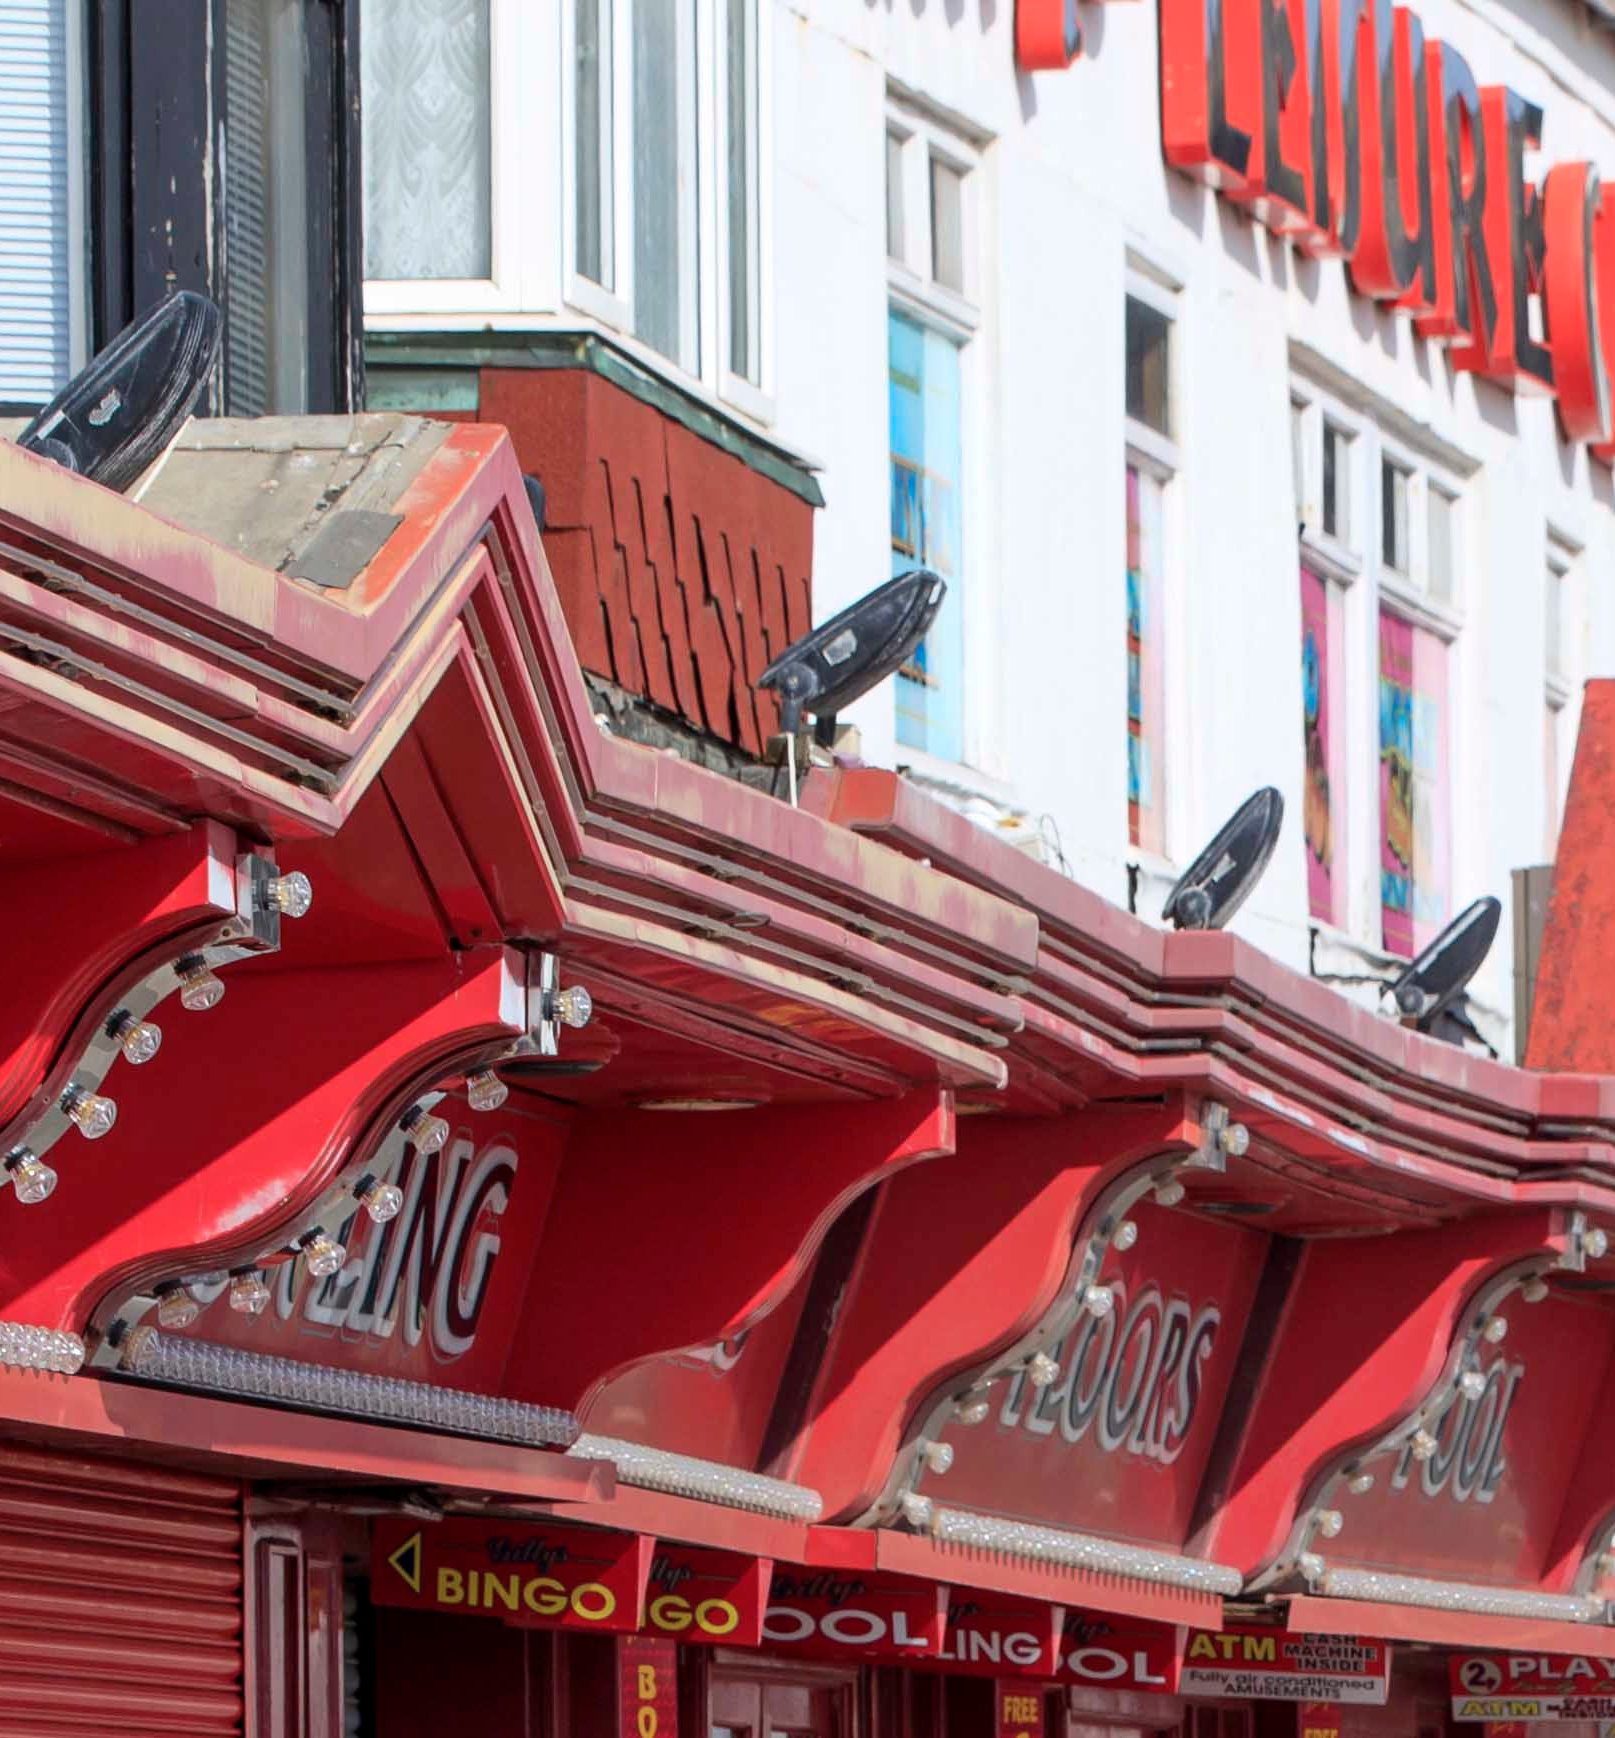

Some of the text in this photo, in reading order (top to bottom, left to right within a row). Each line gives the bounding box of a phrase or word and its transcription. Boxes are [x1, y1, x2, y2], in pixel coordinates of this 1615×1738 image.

[436, 1566, 617, 1621] BINGO
[1188, 1632, 1276, 1662] ATM
[1303, 1632, 1358, 1646] CASH
[1283, 1644, 1377, 1660] MACHINE
[1297, 1657, 1365, 1673] INSIDE
[1188, 1671, 1376, 1691] Fully air conditioned
[1223, 1682, 1341, 1699] AMUSEMENTS
[1004, 1695, 1038, 1724] FREE
[1458, 1700, 1541, 1717] ATM
